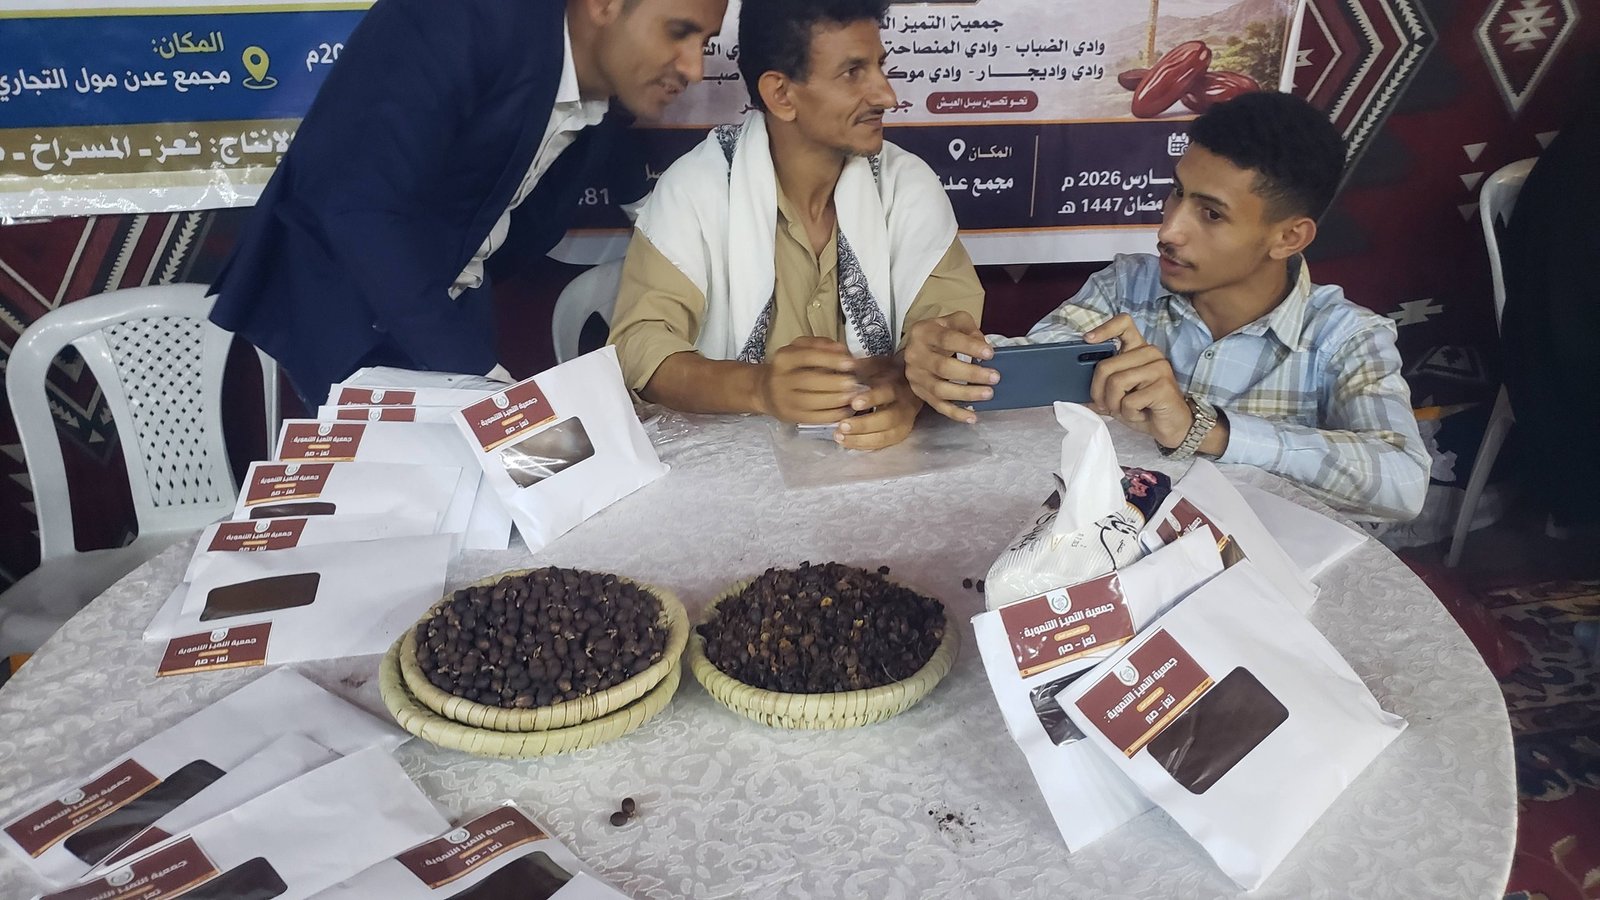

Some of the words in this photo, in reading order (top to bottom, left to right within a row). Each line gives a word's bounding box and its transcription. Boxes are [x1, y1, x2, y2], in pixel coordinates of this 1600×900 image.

[899, 14, 946, 34] التميز
[950, 14, 1004, 33] جمعية
[151, 31, 225, 60] المكان:
[884, 40, 961, 58] المنصاحة
[965, 41, 998, 58] وادي
[1015, 38, 1069, 58] الضباب
[1072, 39, 1106, 58] وادي
[75, 67, 118, 94] مول
[124, 69, 168, 93] عدن
[172, 69, 231, 93] مجمع
[928, 65, 962, 83] وادي
[1071, 63, 1104, 82] وادي
[0, 67, 68, 102] التجاري
[936, 96, 964, 111] العيش
[963, 96, 982, 109] سبل
[982, 95, 1009, 109] تحسين
[1009, 95, 1028, 109] نحو
[30, 134, 132, 171] المسراخ
[155, 131, 201, 164] تعز
[968, 145, 1012, 162] المكان
[937, 175, 969, 190] عد
[972, 176, 1014, 197] مجمع
[1061, 176, 1075, 192] م
[1078, 170, 1121, 187] 2026
[1122, 168, 1174, 190] ارس
[1081, 197, 1124, 213] 1447
[503, 405, 520, 418] التميز
[518, 397, 538, 410] جمعية
[1085, 602, 1115, 618] جمعية
[1059, 610, 1085, 629] التميز
[1082, 634, 1097, 648] تعز
[1152, 657, 1178, 679] جمعية
[1133, 675, 1155, 697] التميز
[1161, 693, 1176, 710] تعز
